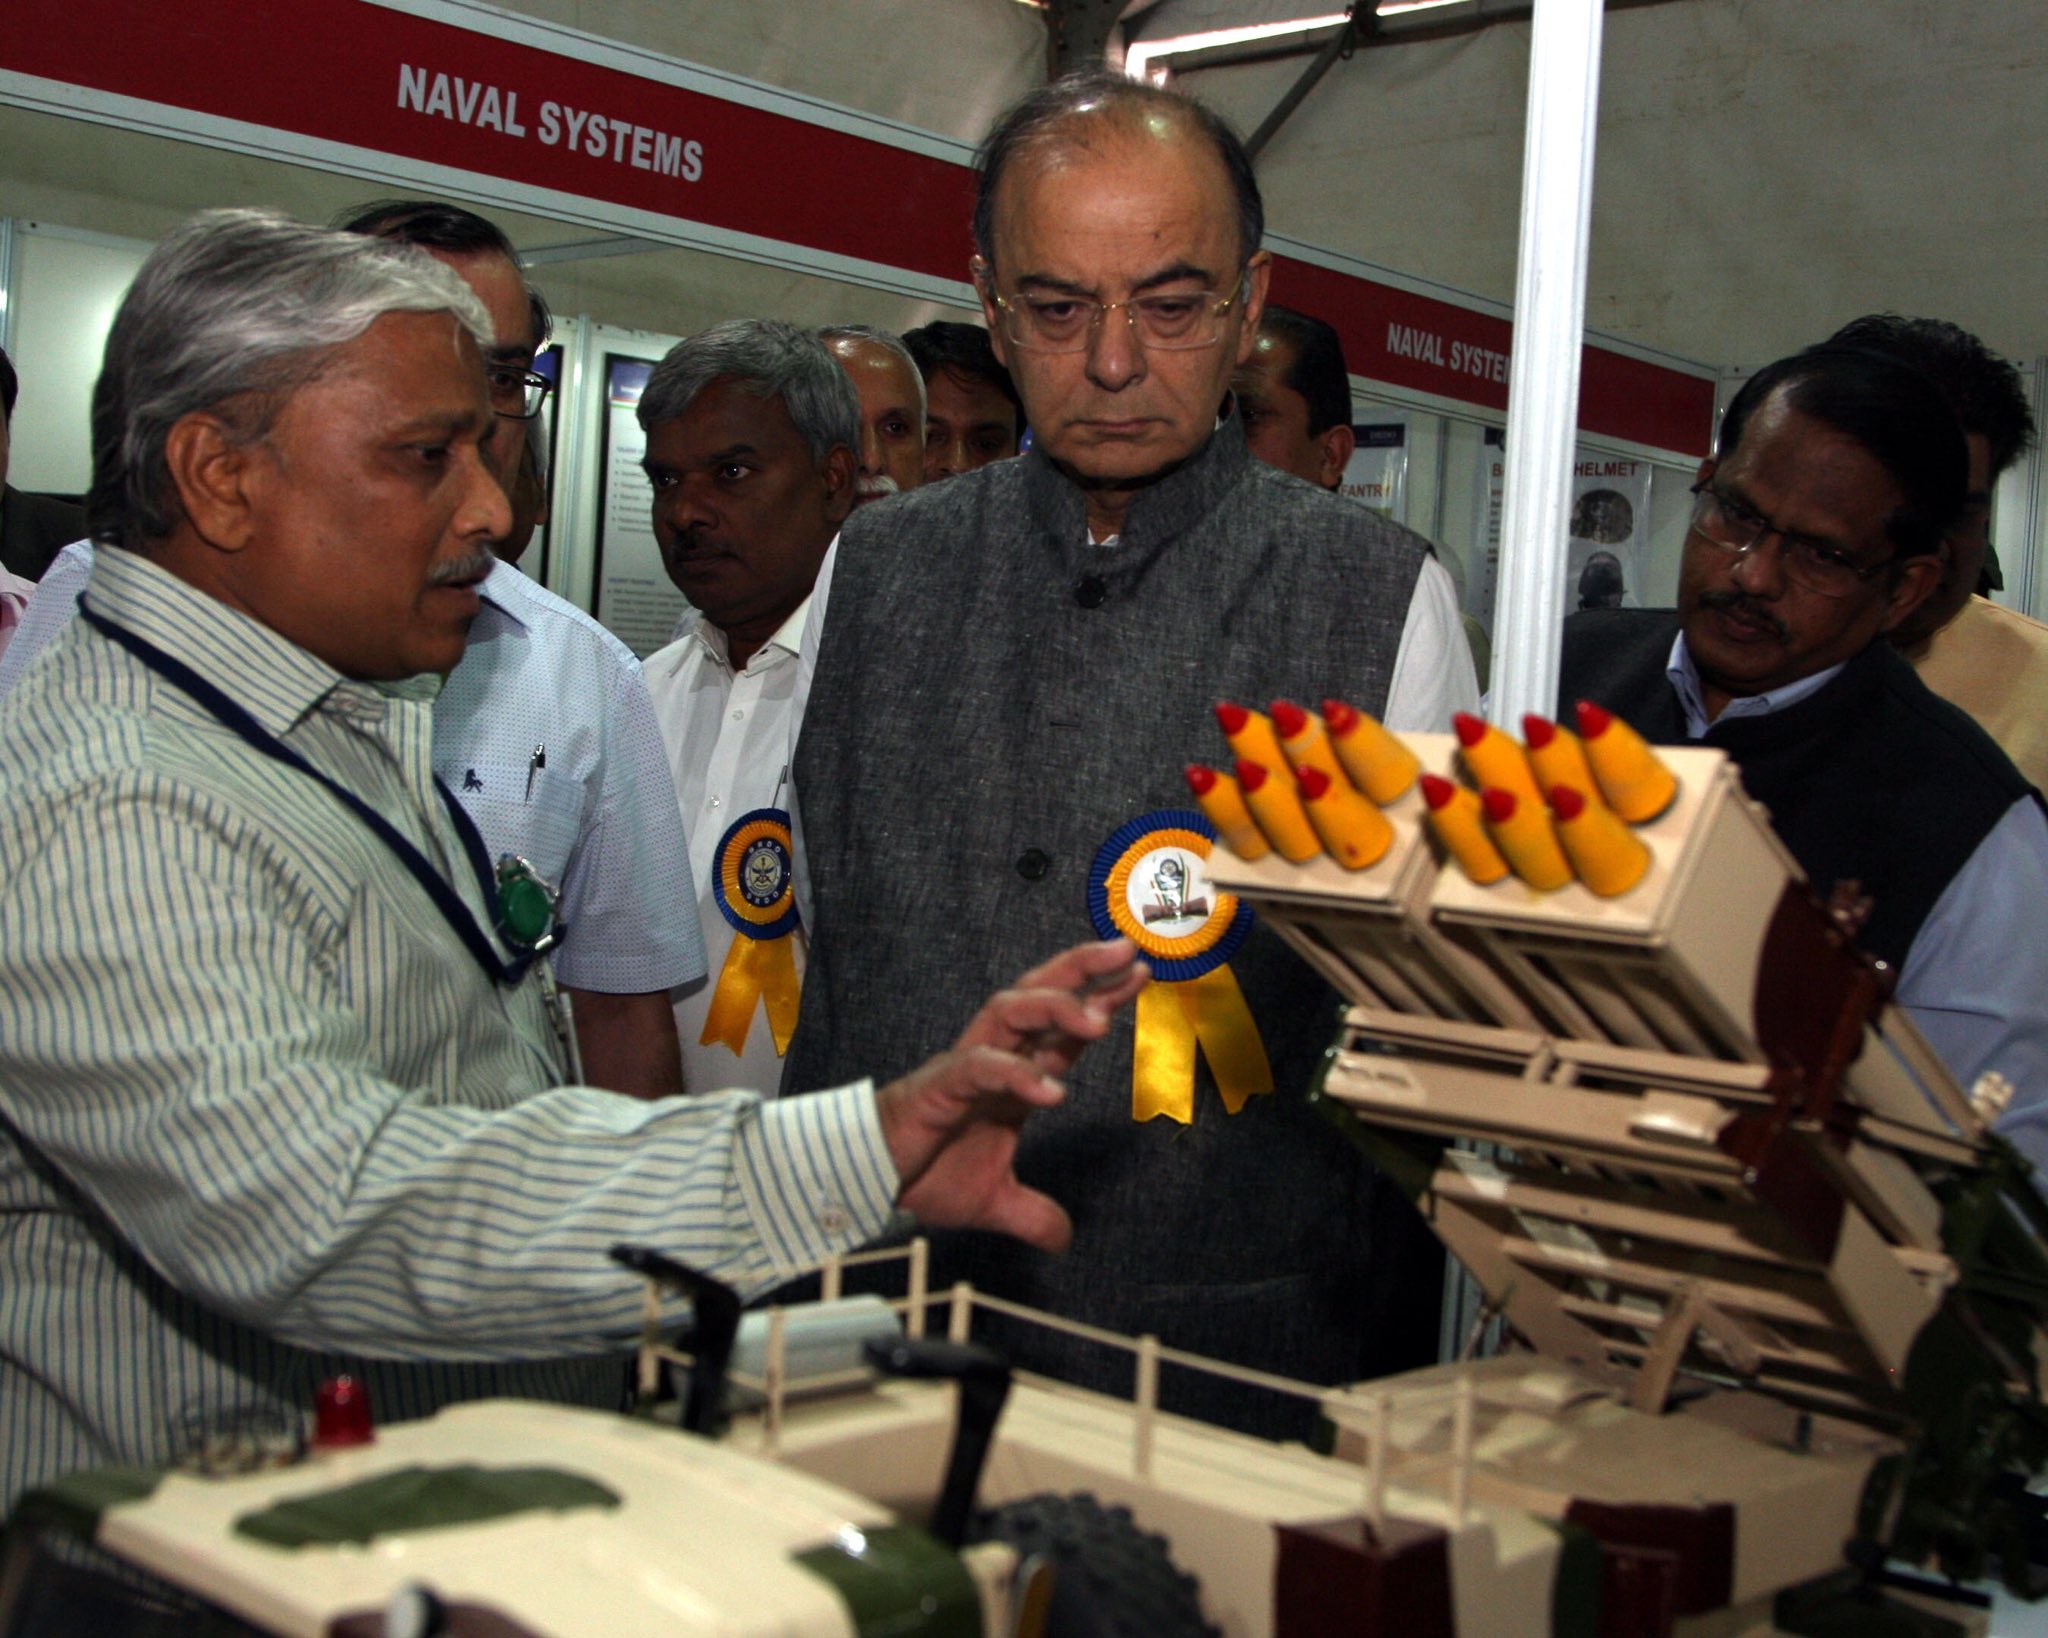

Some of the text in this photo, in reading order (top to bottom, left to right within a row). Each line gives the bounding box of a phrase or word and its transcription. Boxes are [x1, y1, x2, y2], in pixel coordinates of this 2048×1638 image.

[397, 63, 704, 183] NAVAL SYSTEMS
[1388, 323, 1445, 367] NAVAL
[1573, 462, 1638, 477] HELMET
